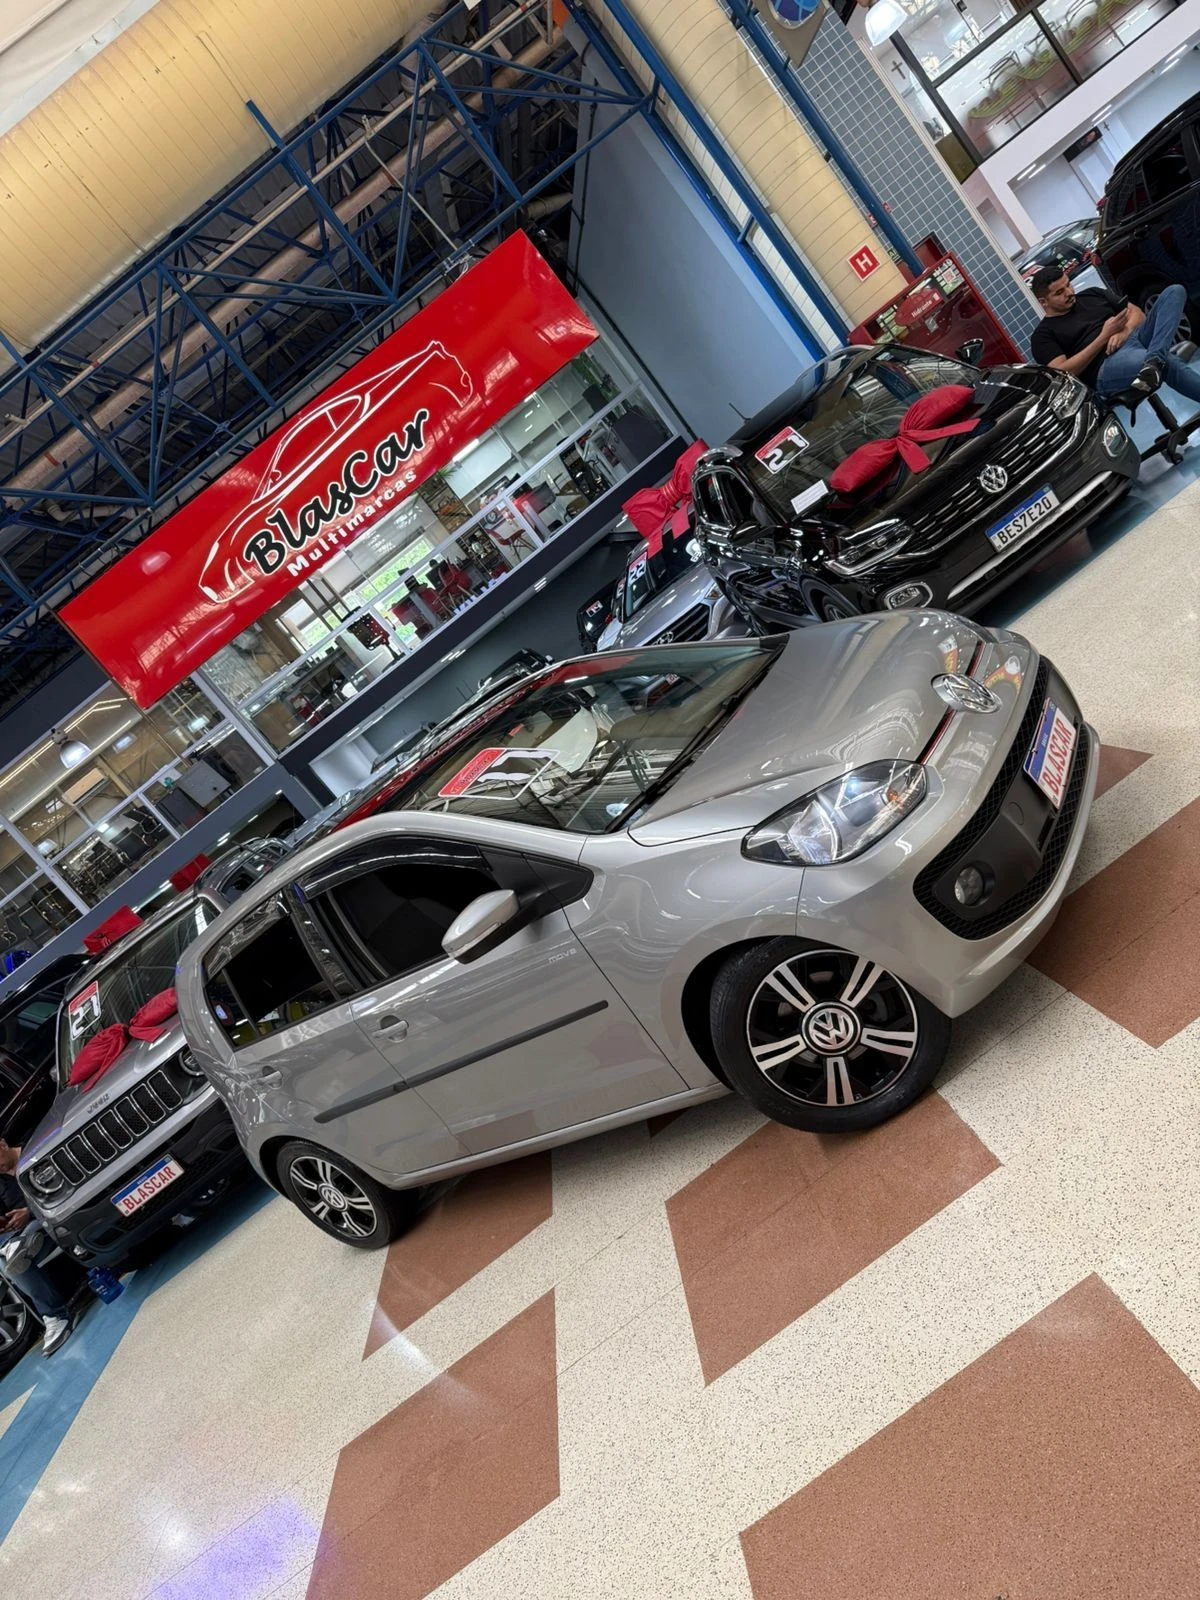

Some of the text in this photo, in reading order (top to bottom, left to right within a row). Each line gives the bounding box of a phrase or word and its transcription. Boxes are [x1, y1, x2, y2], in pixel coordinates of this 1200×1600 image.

[856, 253, 873, 272] H
[911, 300, 933, 318] Hidrante
[764, 434, 806, 471] 21
[244, 409, 429, 576] BlasCar
[286, 470, 417, 577] Multimarcas
[996, 496, 1052, 544] BES7E20
[1042, 717, 1073, 796] BLASCAR
[72, 994, 99, 1037] 21
[122, 1166, 176, 1210] BLASCAR
